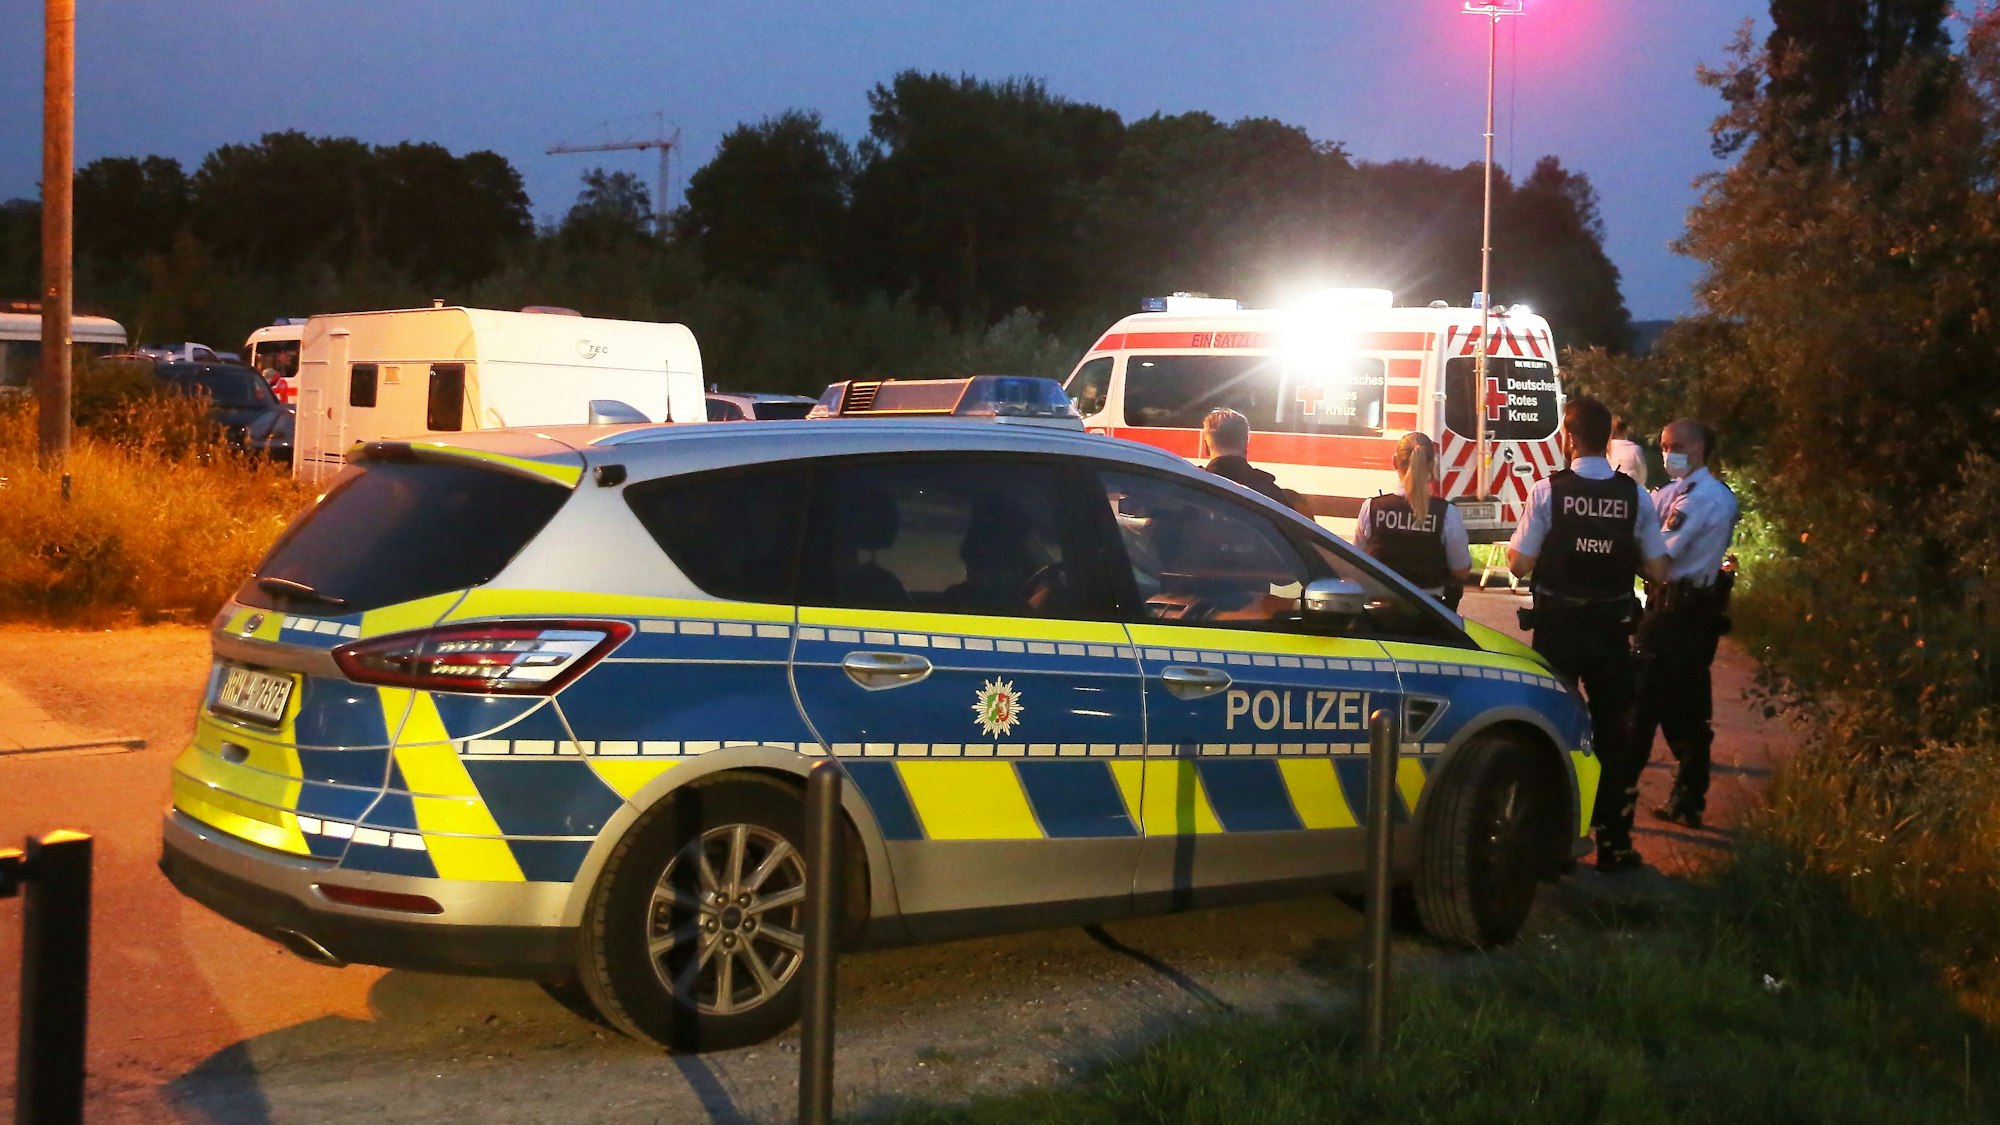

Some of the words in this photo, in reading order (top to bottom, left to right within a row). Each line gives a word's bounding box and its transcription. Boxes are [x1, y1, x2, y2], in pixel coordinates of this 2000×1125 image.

[589, 345, 609, 354] TEC
[1507, 378, 1556, 392] Deutsches
[1508, 394, 1538, 407] Rotes
[1508, 409, 1539, 422] Kreuz
[1563, 495, 1628, 519] POLIZEI
[1576, 537, 1613, 554] NRW
[1226, 689, 1371, 730] POLIZEI
